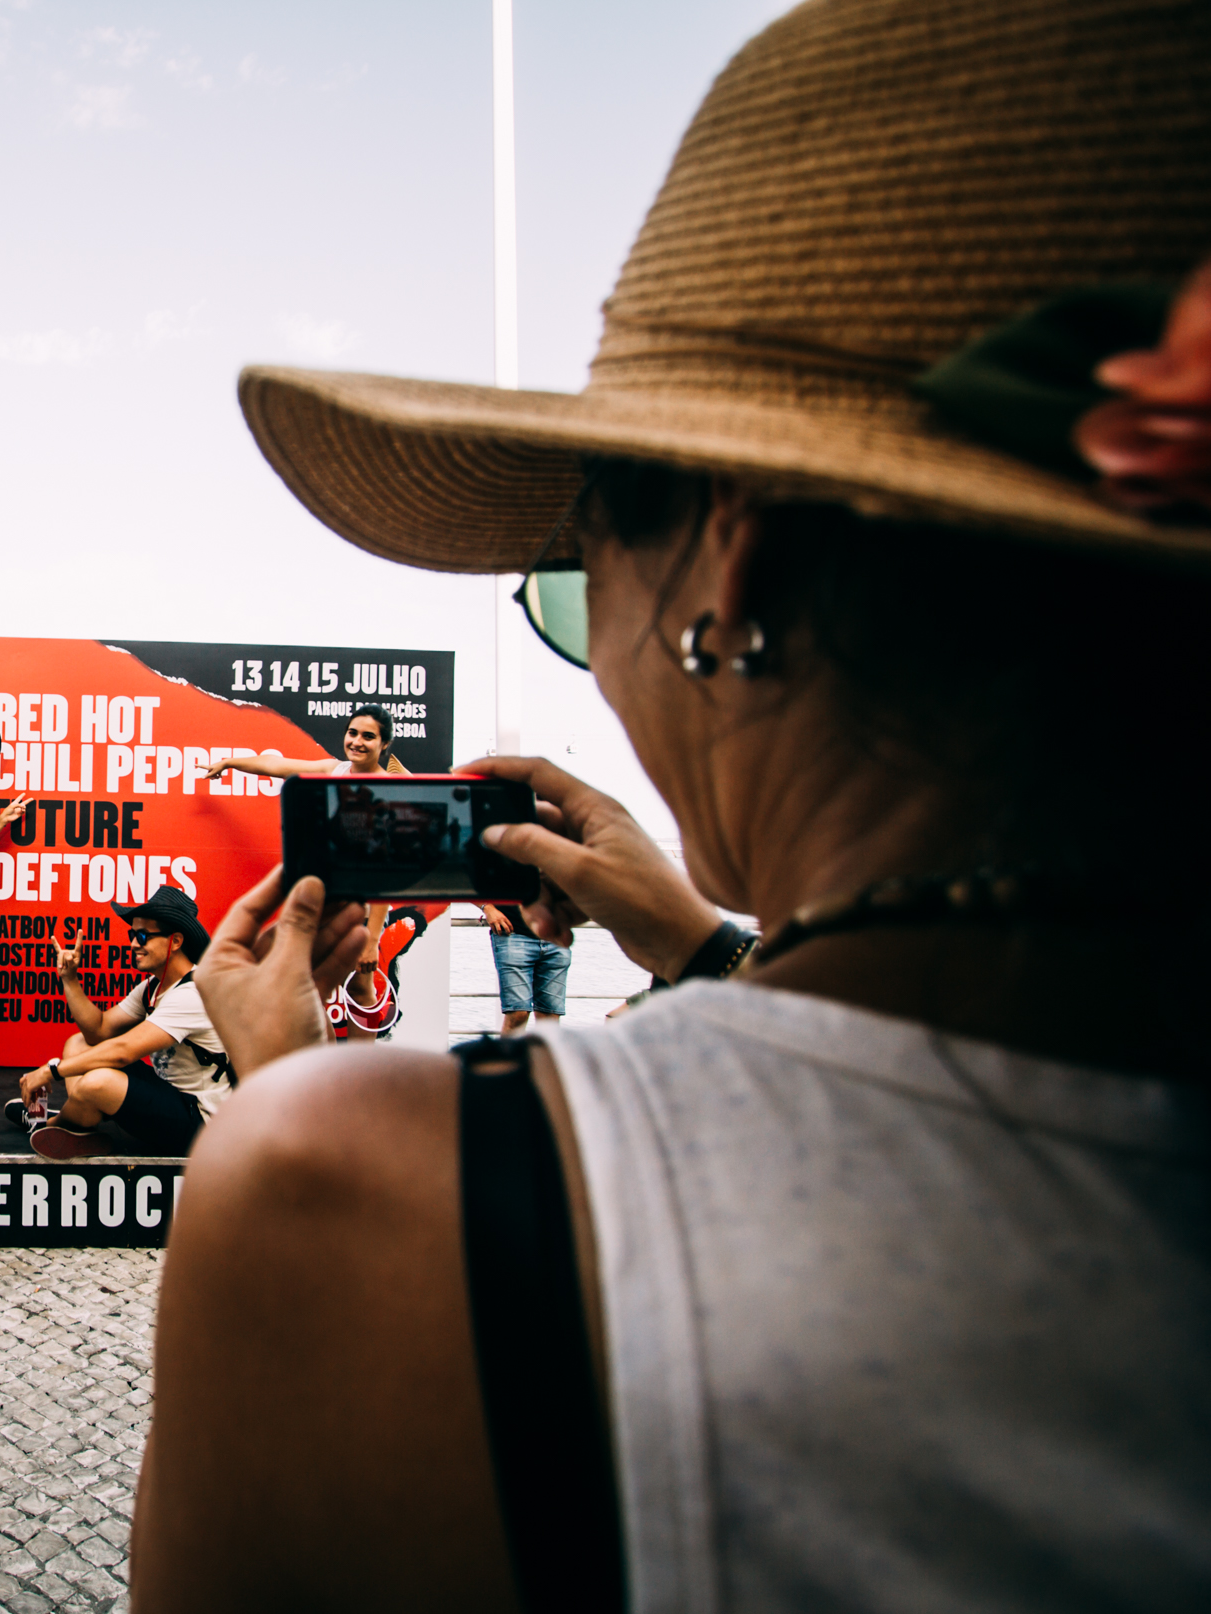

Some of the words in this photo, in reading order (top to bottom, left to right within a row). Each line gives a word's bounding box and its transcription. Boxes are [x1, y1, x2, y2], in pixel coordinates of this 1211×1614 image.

[231, 660, 263, 691] 13
[269, 661, 300, 692] 14
[307, 662, 339, 693] 15
[345, 663, 427, 696] JULHO
[81, 695, 160, 744] HOT
[308, 701, 353, 718] PARQUE
[393, 722, 427, 738] ISBOA
[63, 916, 110, 941] SLIM
[77, 973, 151, 997] RAMM
